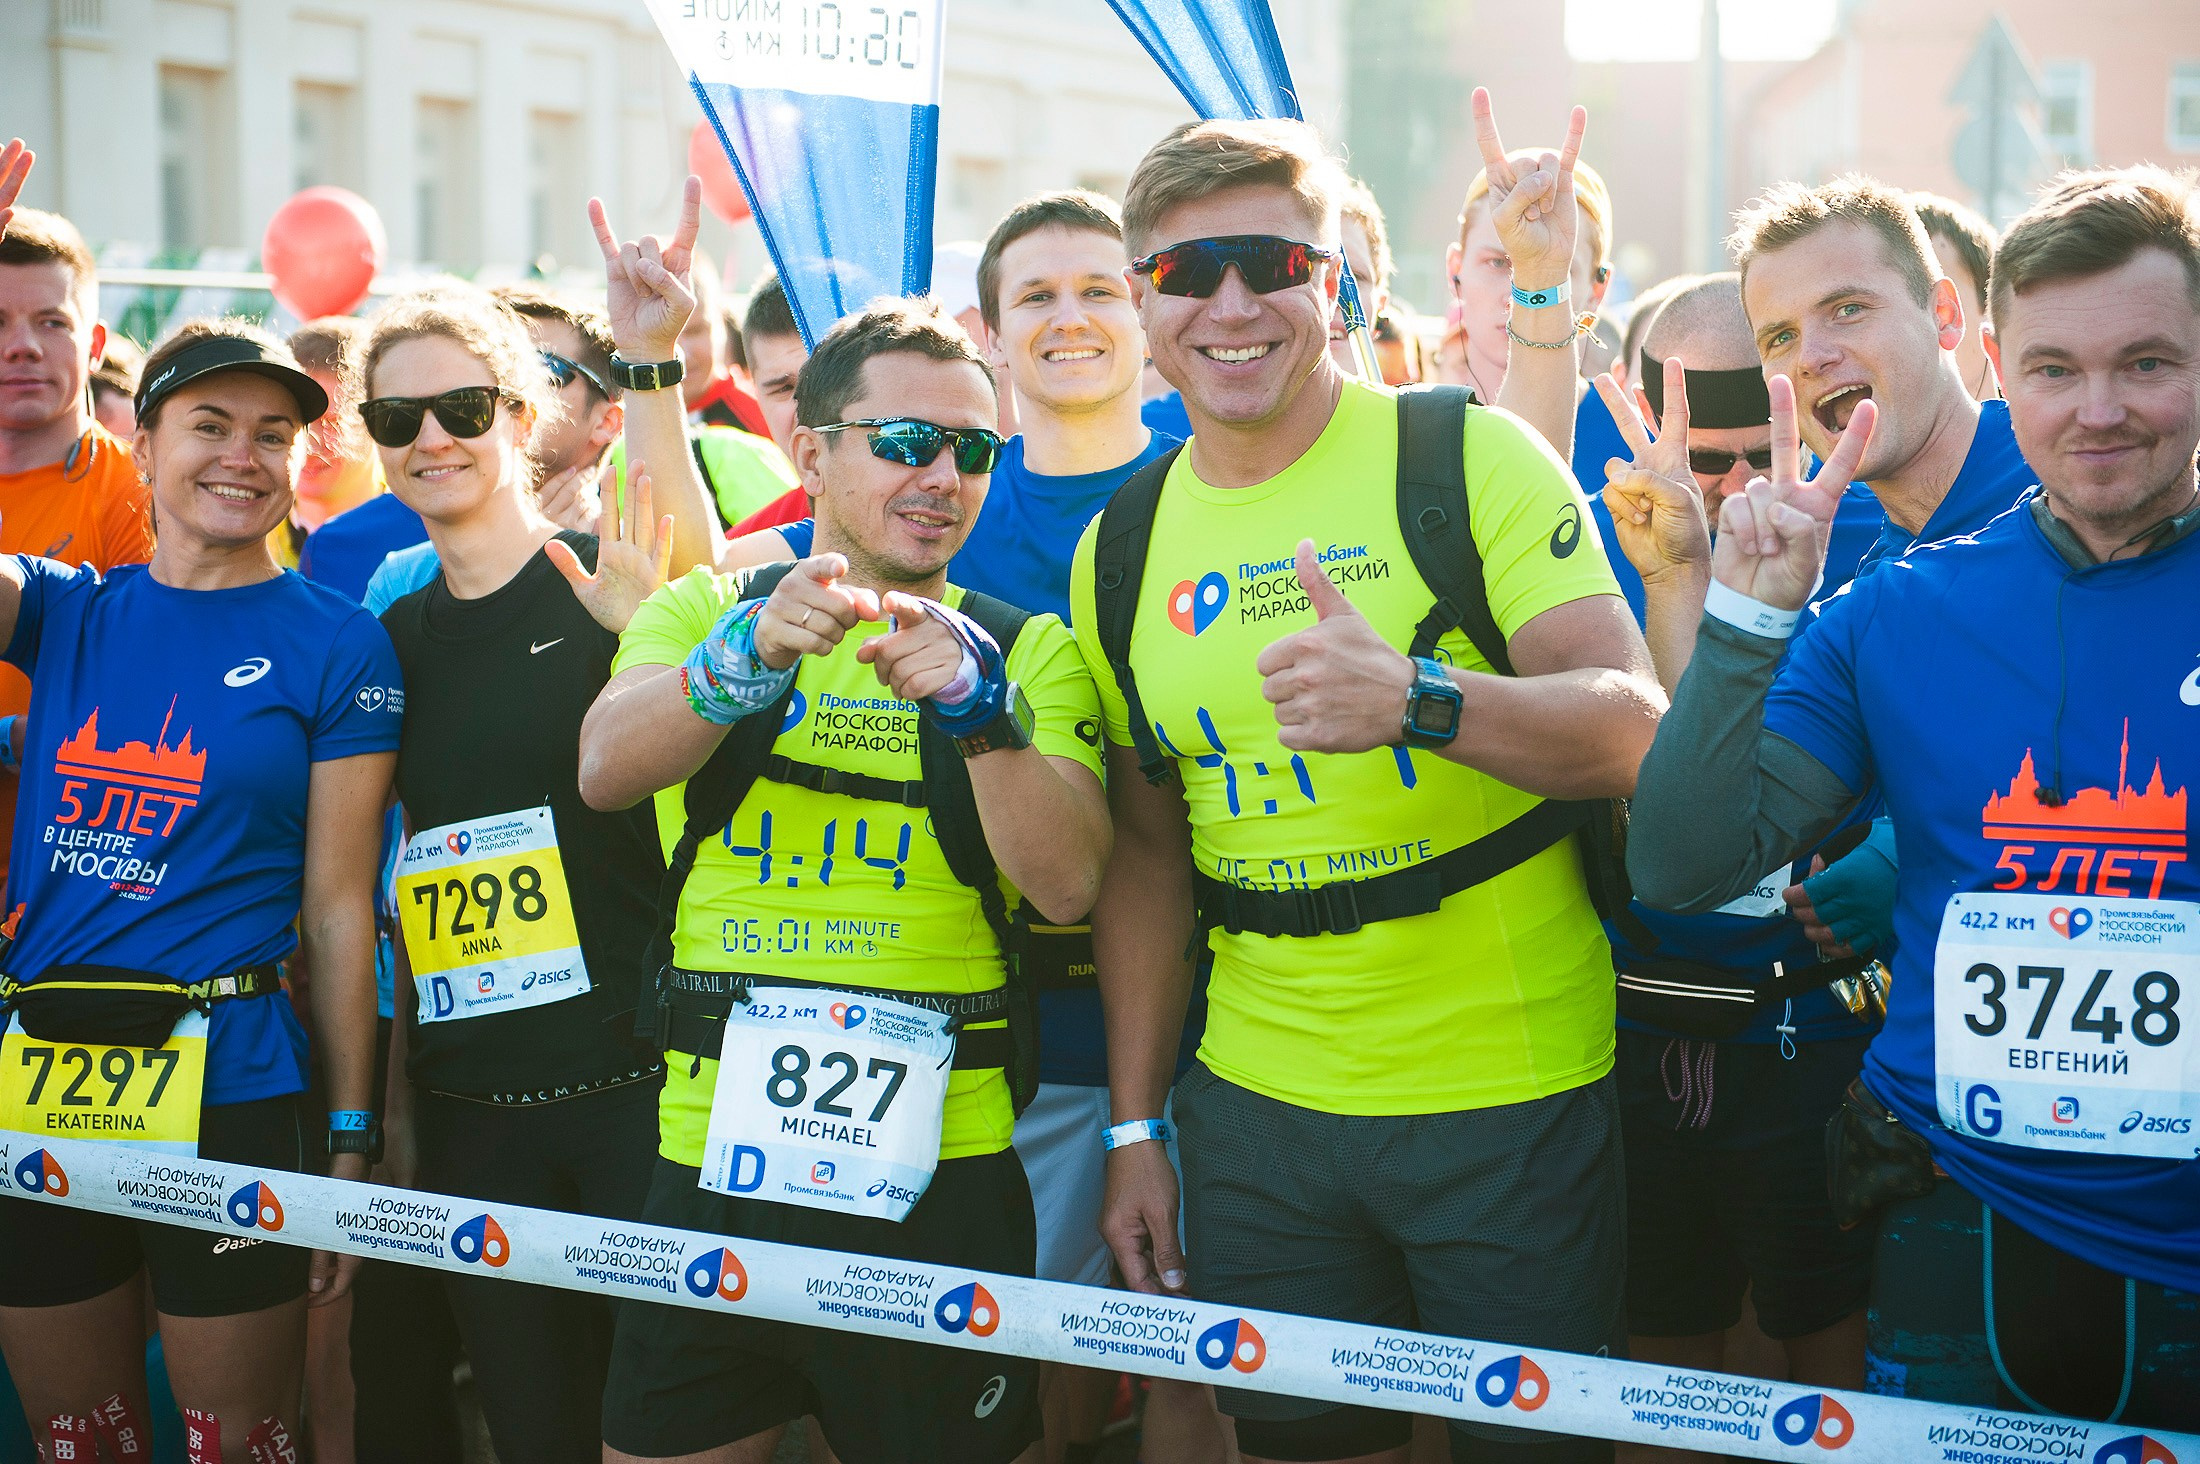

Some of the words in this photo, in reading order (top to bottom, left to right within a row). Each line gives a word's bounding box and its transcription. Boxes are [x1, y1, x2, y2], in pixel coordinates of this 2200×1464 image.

[1239, 544, 1368, 581] Промсвьбанк
[1240, 558, 1390, 603] МОСКСКИЙ
[818, 692, 920, 714] Промсвязьба
[814, 712, 919, 734] МОСКОВС
[811, 731, 918, 755] МАРАФОН
[55, 780, 88, 824] 5
[87, 786, 198, 837] ЛЕТ
[43, 825, 55, 843] В
[58, 827, 136, 855] ЦЕНТРЕ
[475, 826, 534, 844] МОСКОВСКИЙ
[477, 839, 520, 853] МАРАФОН
[722, 809, 912, 891] 4:14
[1326, 838, 1433, 874] MINUTE
[50, 849, 168, 886] МОСКВЫ
[1993, 846, 2035, 890] 5
[2036, 848, 2187, 900] ЛЕТ
[109, 881, 156, 896] 2013-2017
[1747, 886, 1775, 898] SICS
[412, 865, 548, 941] 7298
[2099, 908, 2175, 922] Промсвязьбанк
[1959, 912, 1998, 931] 42,2
[2099, 920, 2186, 933] МОСКОВСКИЙ
[461, 936, 502, 957] ANNA
[722, 918, 810, 953] 06:01
[825, 919, 901, 939] MINUTE
[825, 939, 854, 954] KM
[2098, 932, 2161, 944] МАРАФОН
[540, 969, 572, 985] asics
[687, 974, 724, 993] TRAIL
[431, 975, 455, 1018] D
[961, 992, 999, 1015] ULTRA
[1963, 962, 2180, 1047] 3748
[746, 1004, 787, 1021] 42,2
[872, 1007, 929, 1028] Промсвязьбанк
[869, 1027, 916, 1044] МАРАФОН
[870, 1017, 934, 1039] МОСКОВСКИЙ
[2008, 1048, 2128, 1075] ЕВГЕНИЙ
[22, 1048, 180, 1107] 7297
[766, 1045, 908, 1123] 827
[46, 1113, 146, 1131] EKATERINA
[1965, 1084, 2002, 1137] G
[780, 1116, 877, 1148] MICHAEL
[2024, 1124, 2106, 1140] Промсвязьбанк
[2143, 1117, 2191, 1133] asics
[147, 1165, 225, 1189] МАРАФОН
[727, 1144, 766, 1193] D
[117, 1178, 222, 1208] МОСКОВСКИЙ
[784, 1182, 855, 1202] Промсвязьбанк
[886, 1184, 919, 1204] asics
[130, 1198, 223, 1223] Промсвязьбанк
[368, 1197, 450, 1222] МАРАФОН
[336, 1211, 445, 1241] МОСКОВСКИЙ
[348, 1232, 445, 1258] Промсвязьбанк
[600, 1231, 686, 1255] МАРАФОН
[565, 1245, 680, 1275] МОСКОВСКИЙ
[576, 1266, 677, 1293] Промсвязьбанк
[844, 1265, 934, 1289] МАРАФОН
[806, 1278, 928, 1308] МОСКОВСКИЙ
[818, 1301, 925, 1328] Промсвязьбанк
[1101, 1300, 1196, 1324] МАРАФОН
[1061, 1313, 1190, 1345] МОСКОВСКИЙ
[1073, 1336, 1185, 1365] Промсвязьбанк
[1374, 1336, 1475, 1361] МАРАФОН
[1332, 1348, 1468, 1381] МОСКОВСКИЙ
[1344, 1372, 1464, 1403] Промсвязьбанк
[1666, 1374, 1772, 1399] МАРАФОН
[1620, 1386, 1768, 1419] МОСКОВСКИЙ
[1632, 1409, 1760, 1441] Промсвязьбанк
[1976, 1414, 2089, 1440] МАРАФОН
[1928, 1425, 2084, 1459] МОСКОВСКИЙ
